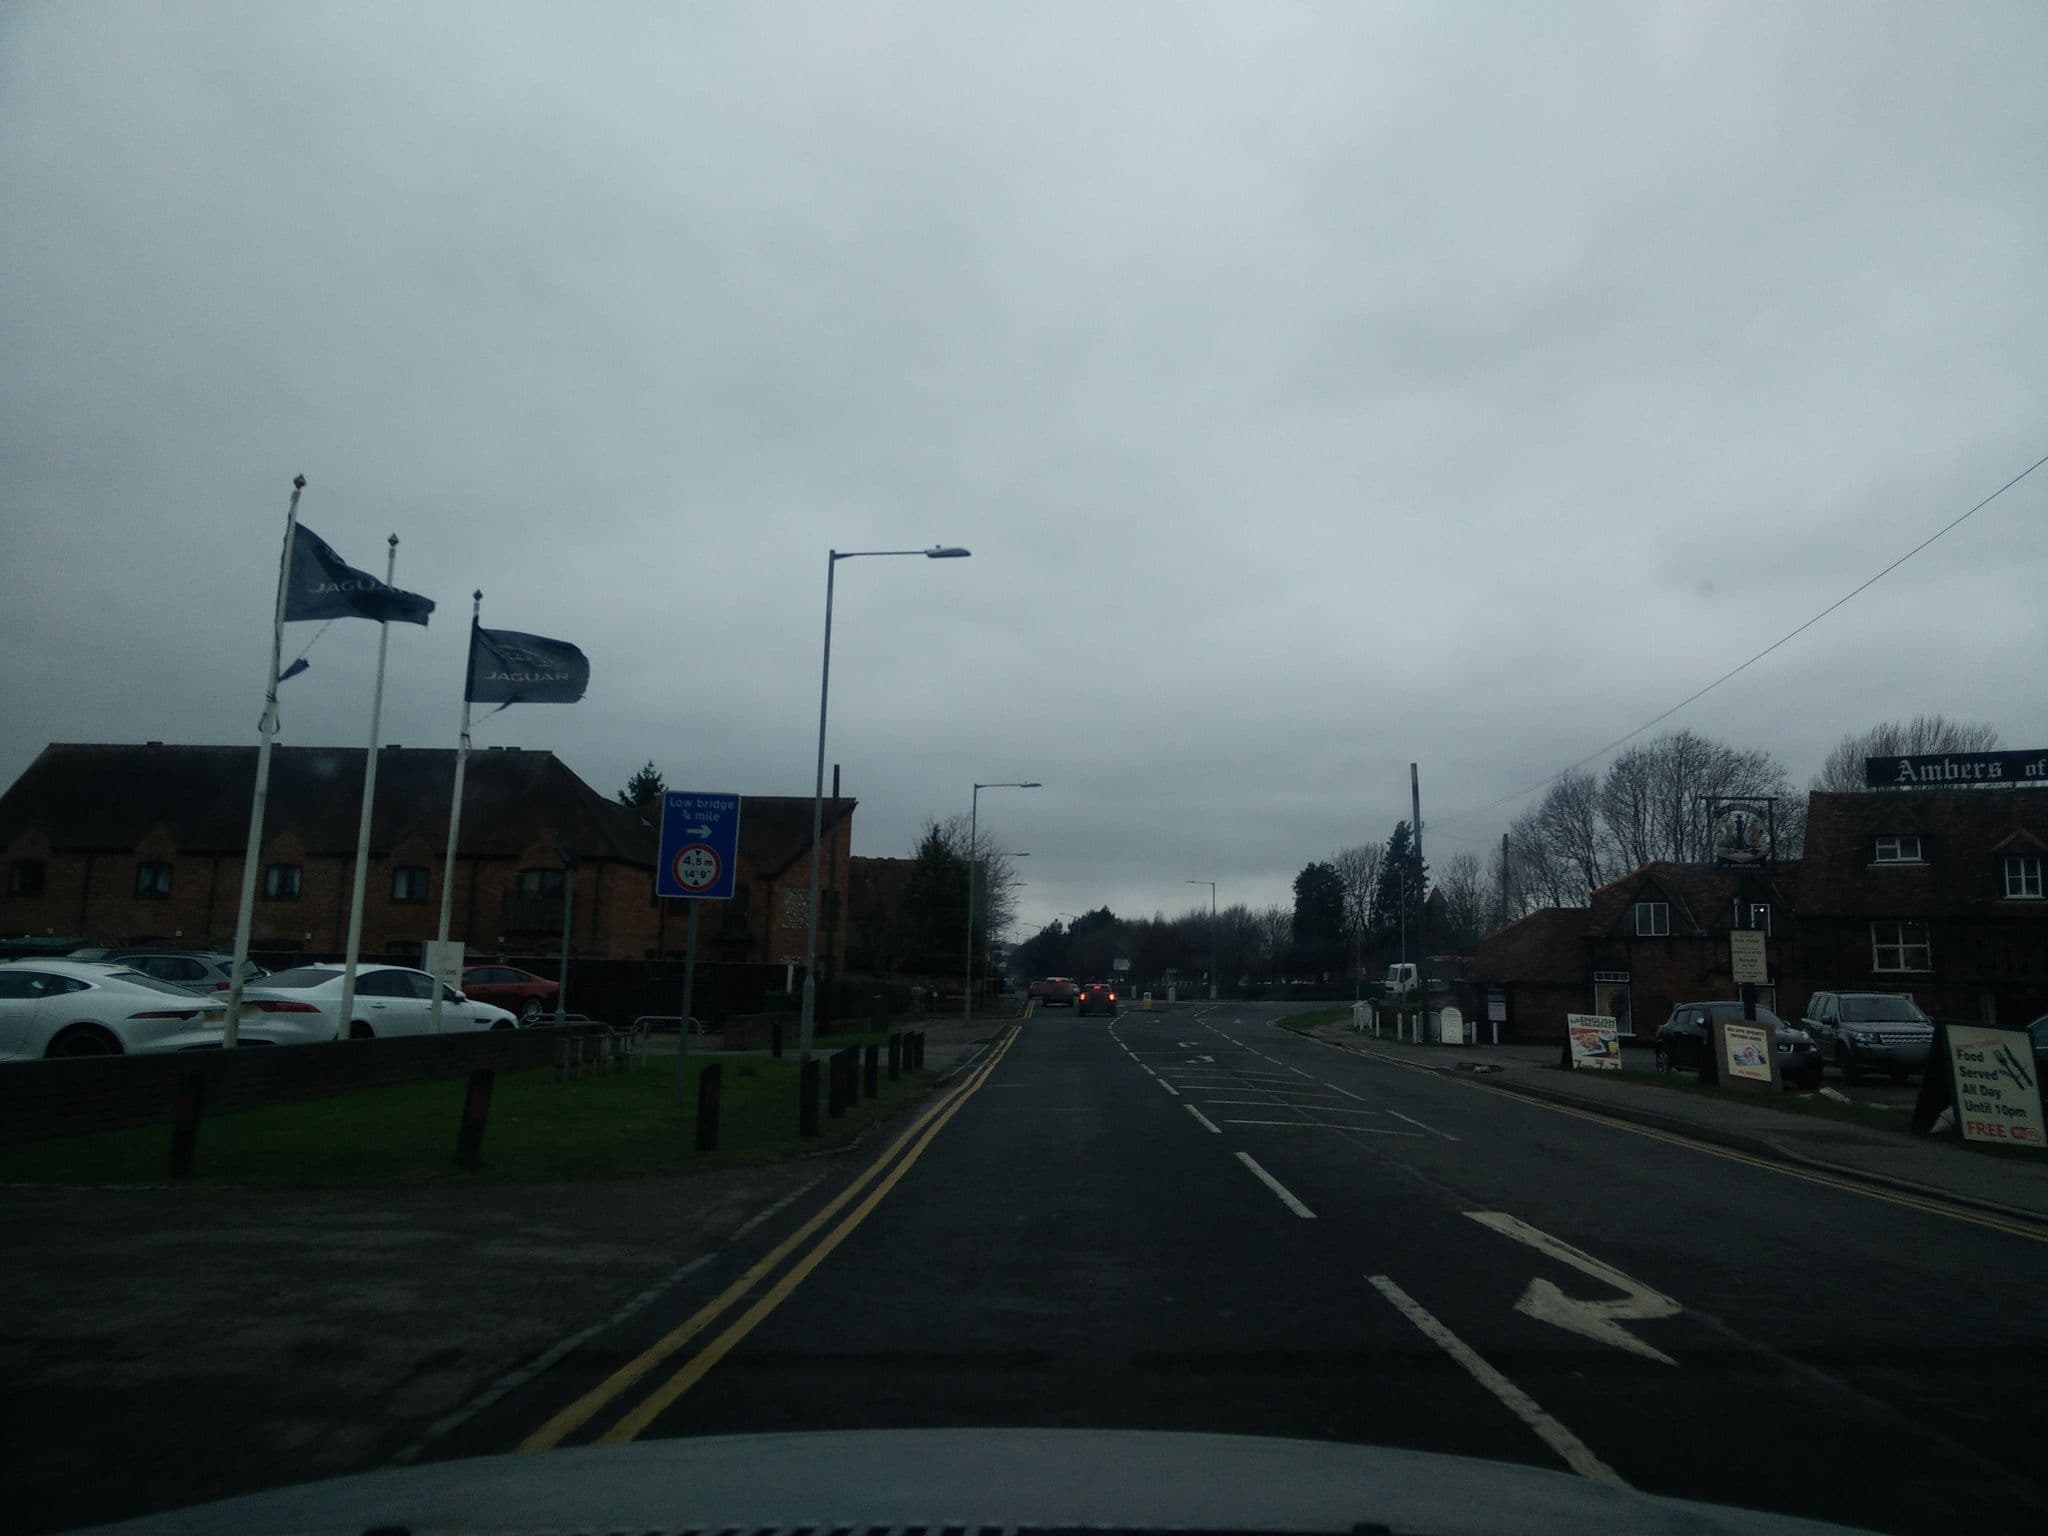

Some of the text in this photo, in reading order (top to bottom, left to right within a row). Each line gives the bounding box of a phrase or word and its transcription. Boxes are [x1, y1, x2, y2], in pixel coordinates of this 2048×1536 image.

[307, 579, 403, 594] JAGUA
[483, 671, 569, 681] JAGUAR
[1894, 757, 2004, 782] Ambers
[669, 797, 735, 812] Low bridge
[695, 810, 720, 822] mile
[1957, 1048, 1984, 1063] Food
[1959, 1066, 1999, 1081] Served
[1963, 1083, 2001, 1100] All Day
[1965, 1100, 1992, 1114] Until
[1967, 1121, 2007, 1138] FREE
